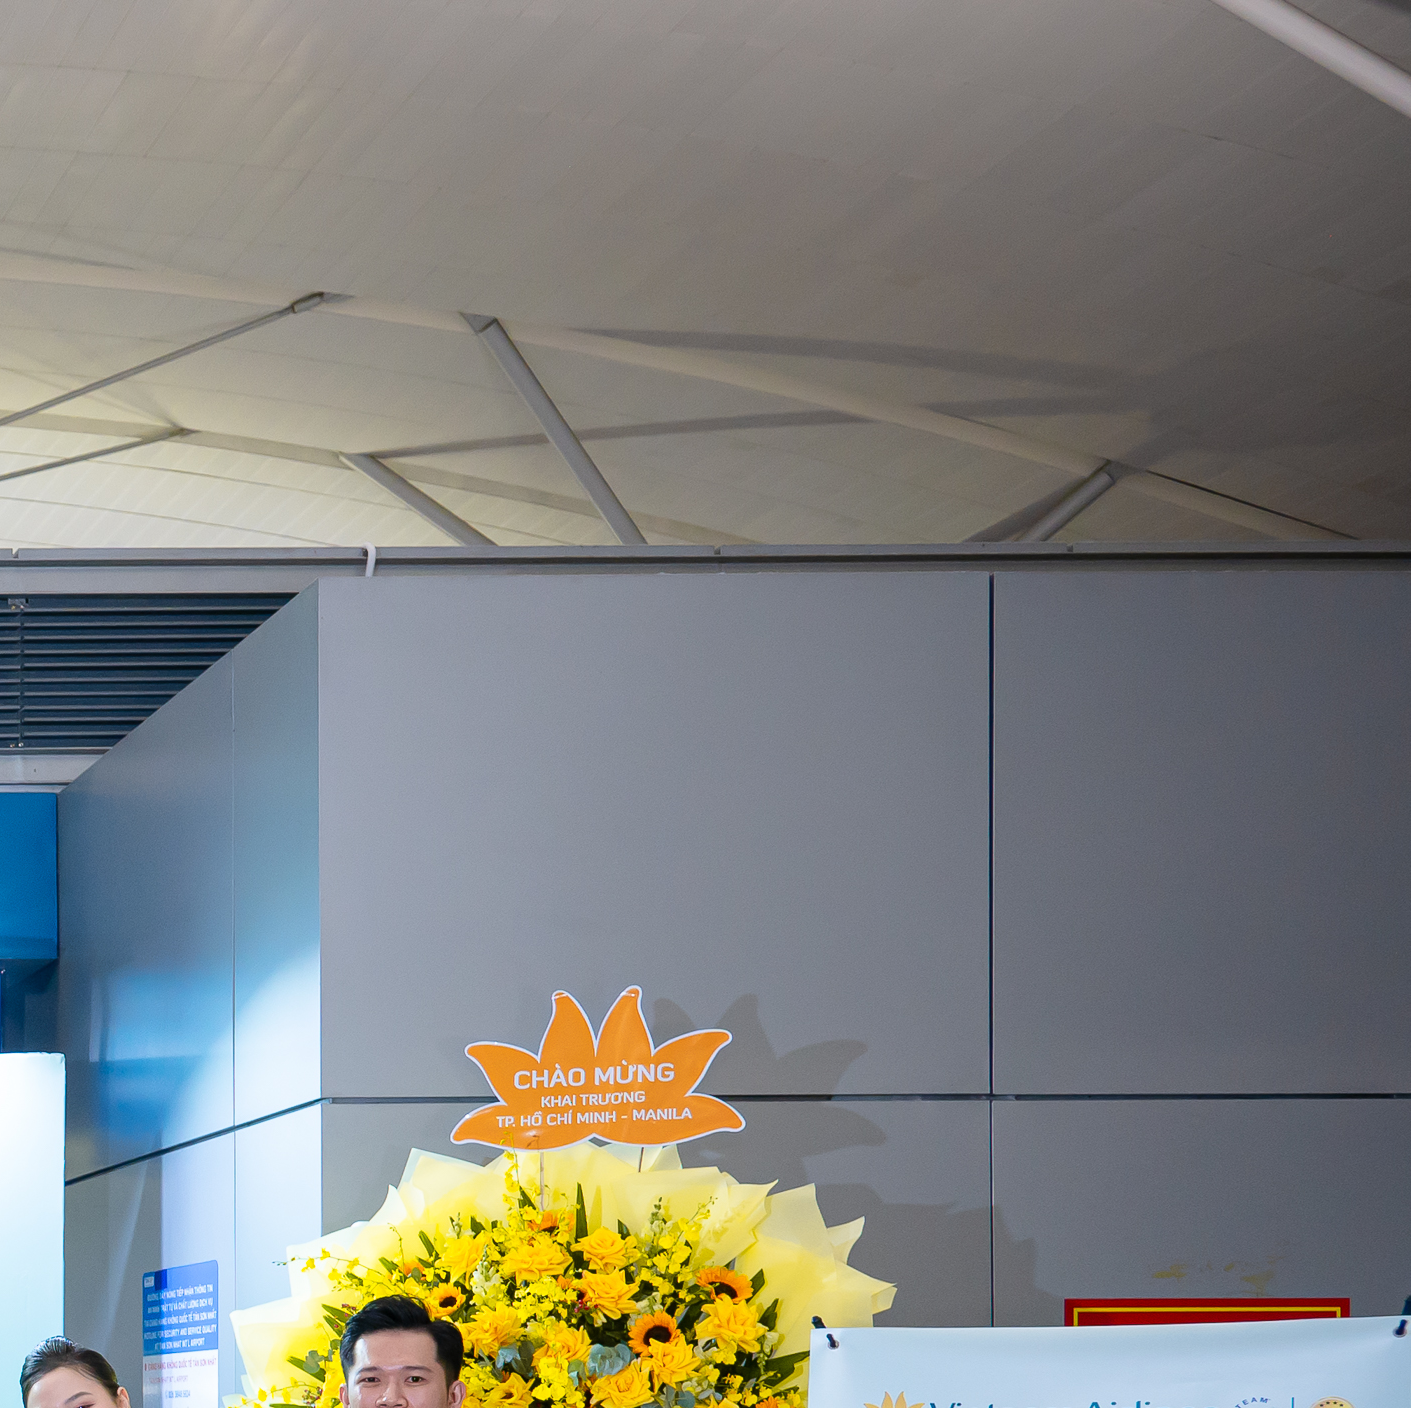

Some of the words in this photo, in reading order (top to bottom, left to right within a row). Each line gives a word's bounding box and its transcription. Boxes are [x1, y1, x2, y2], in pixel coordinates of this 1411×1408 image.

[513, 1063, 586, 1089] CHÀO
[594, 1059, 675, 1086] MỪNG
[541, 1095, 576, 1107] KHAI
[579, 1091, 646, 1106] TRƯƠNG
[496, 1115, 516, 1128] TP.
[546, 1110, 573, 1125] CHÍ
[576, 1111, 617, 1124] MINH
[632, 1107, 692, 1121] MANILA
